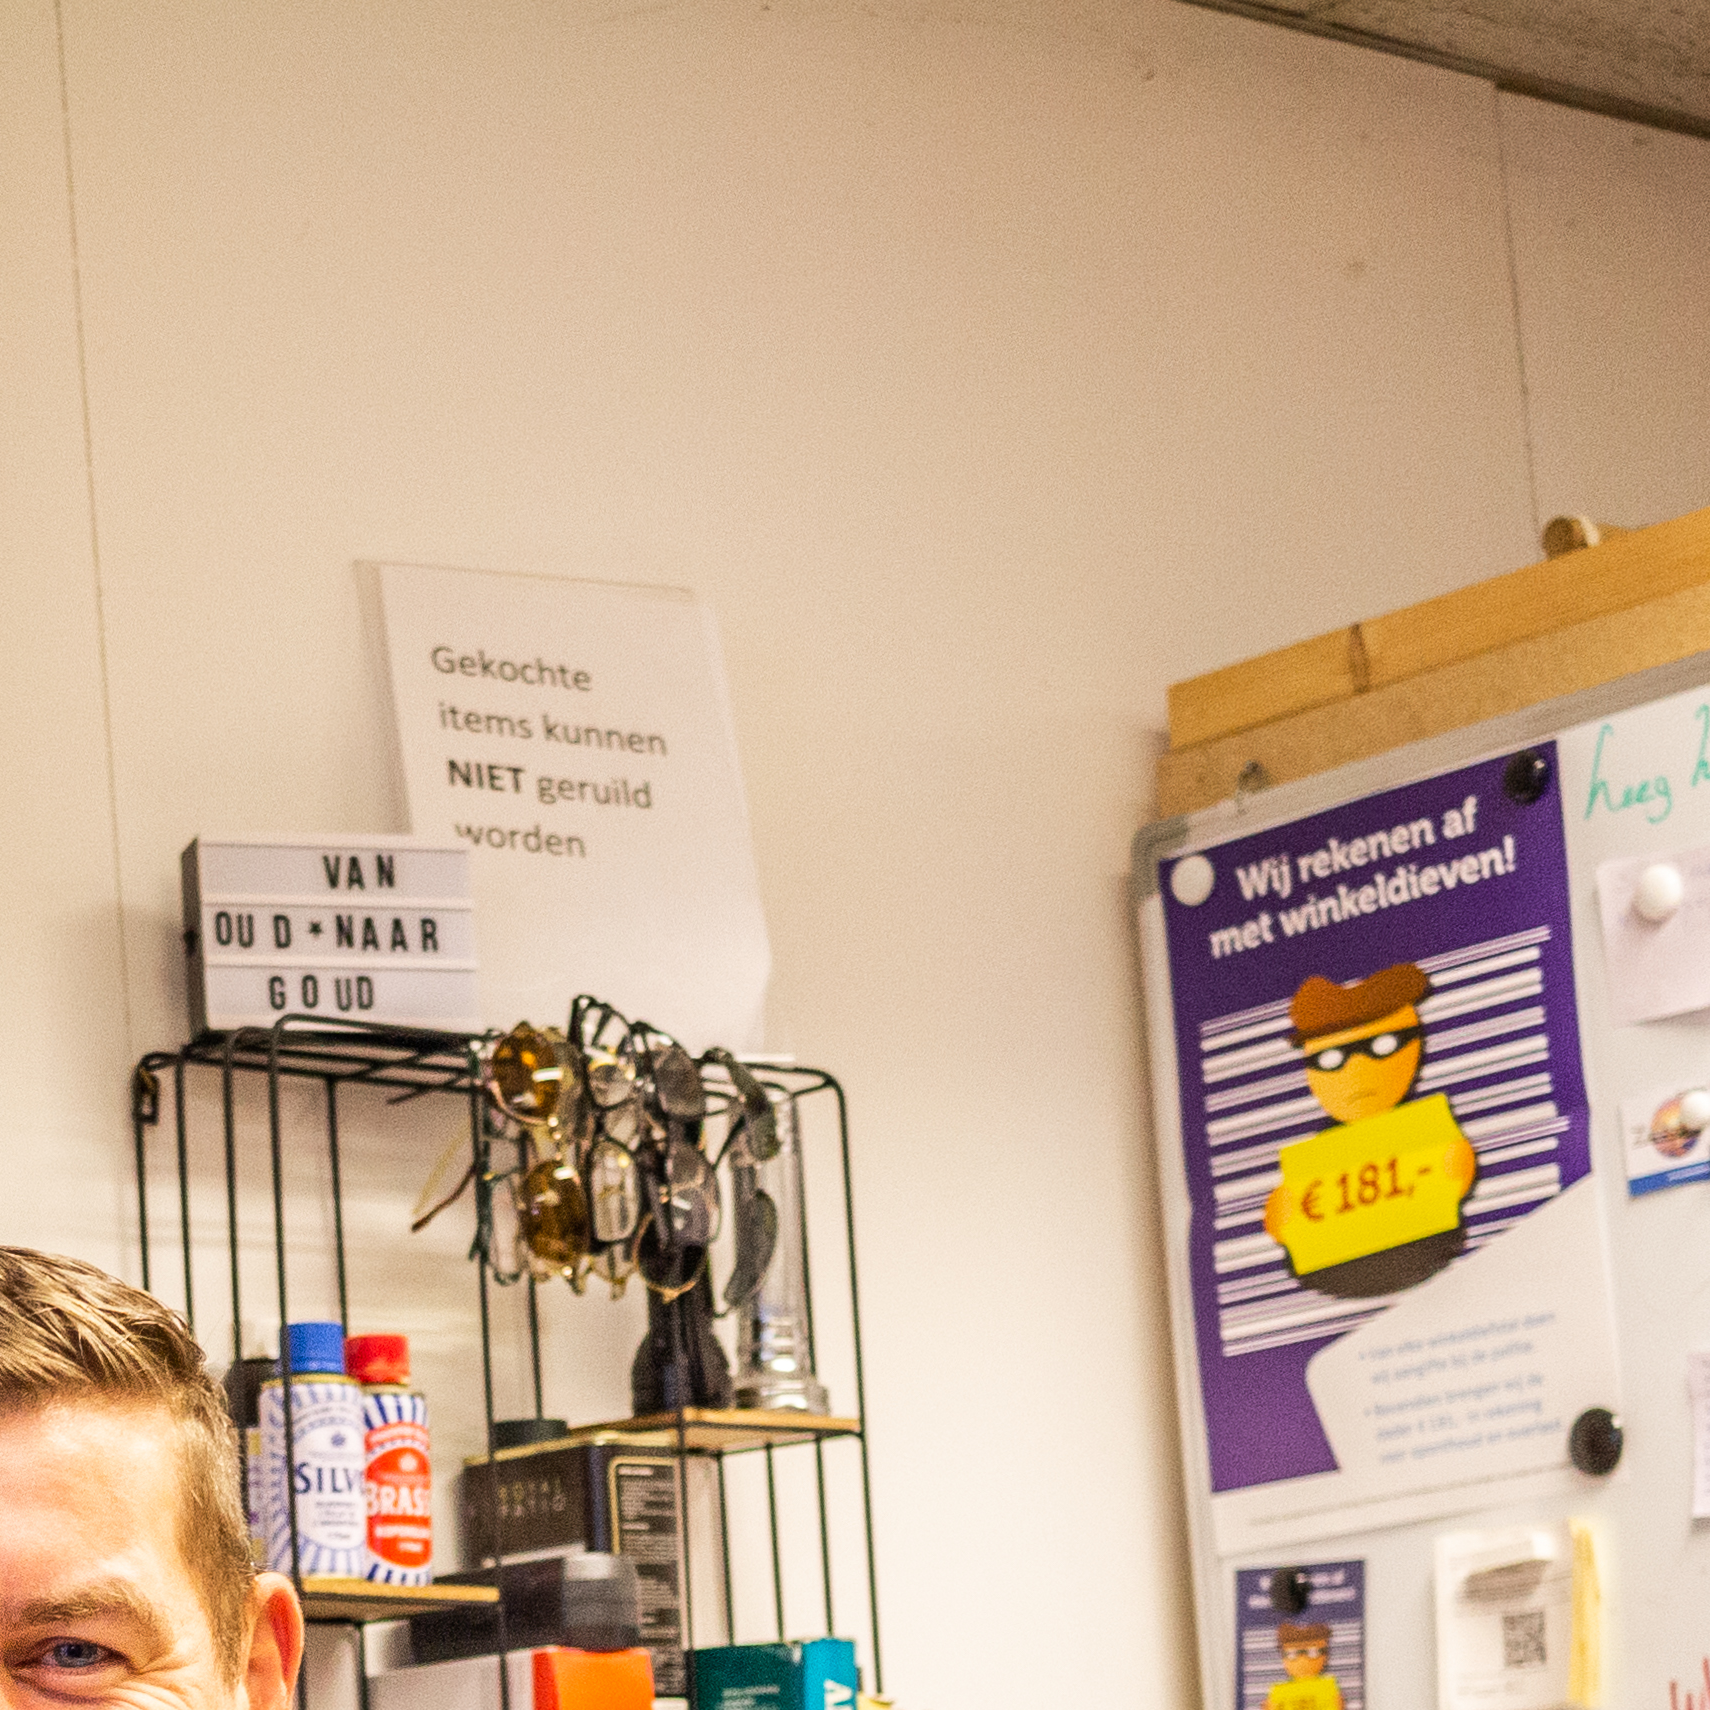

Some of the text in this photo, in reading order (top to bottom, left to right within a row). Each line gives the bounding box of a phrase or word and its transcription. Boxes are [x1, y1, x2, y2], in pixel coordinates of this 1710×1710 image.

[431, 645, 592, 692] Gekochte
[439, 701, 667, 756] items kunnen
[447, 759, 652, 809] NIET geruild
[454, 823, 587, 858] worden
[1236, 794, 1479, 901] Wij rekenen af
[322, 853, 396, 890] VAN
[1209, 833, 1517, 961] met winkeldieven!
[268, 974, 375, 1012] GOUD
[1336, 1155, 1433, 1215] 181,-
